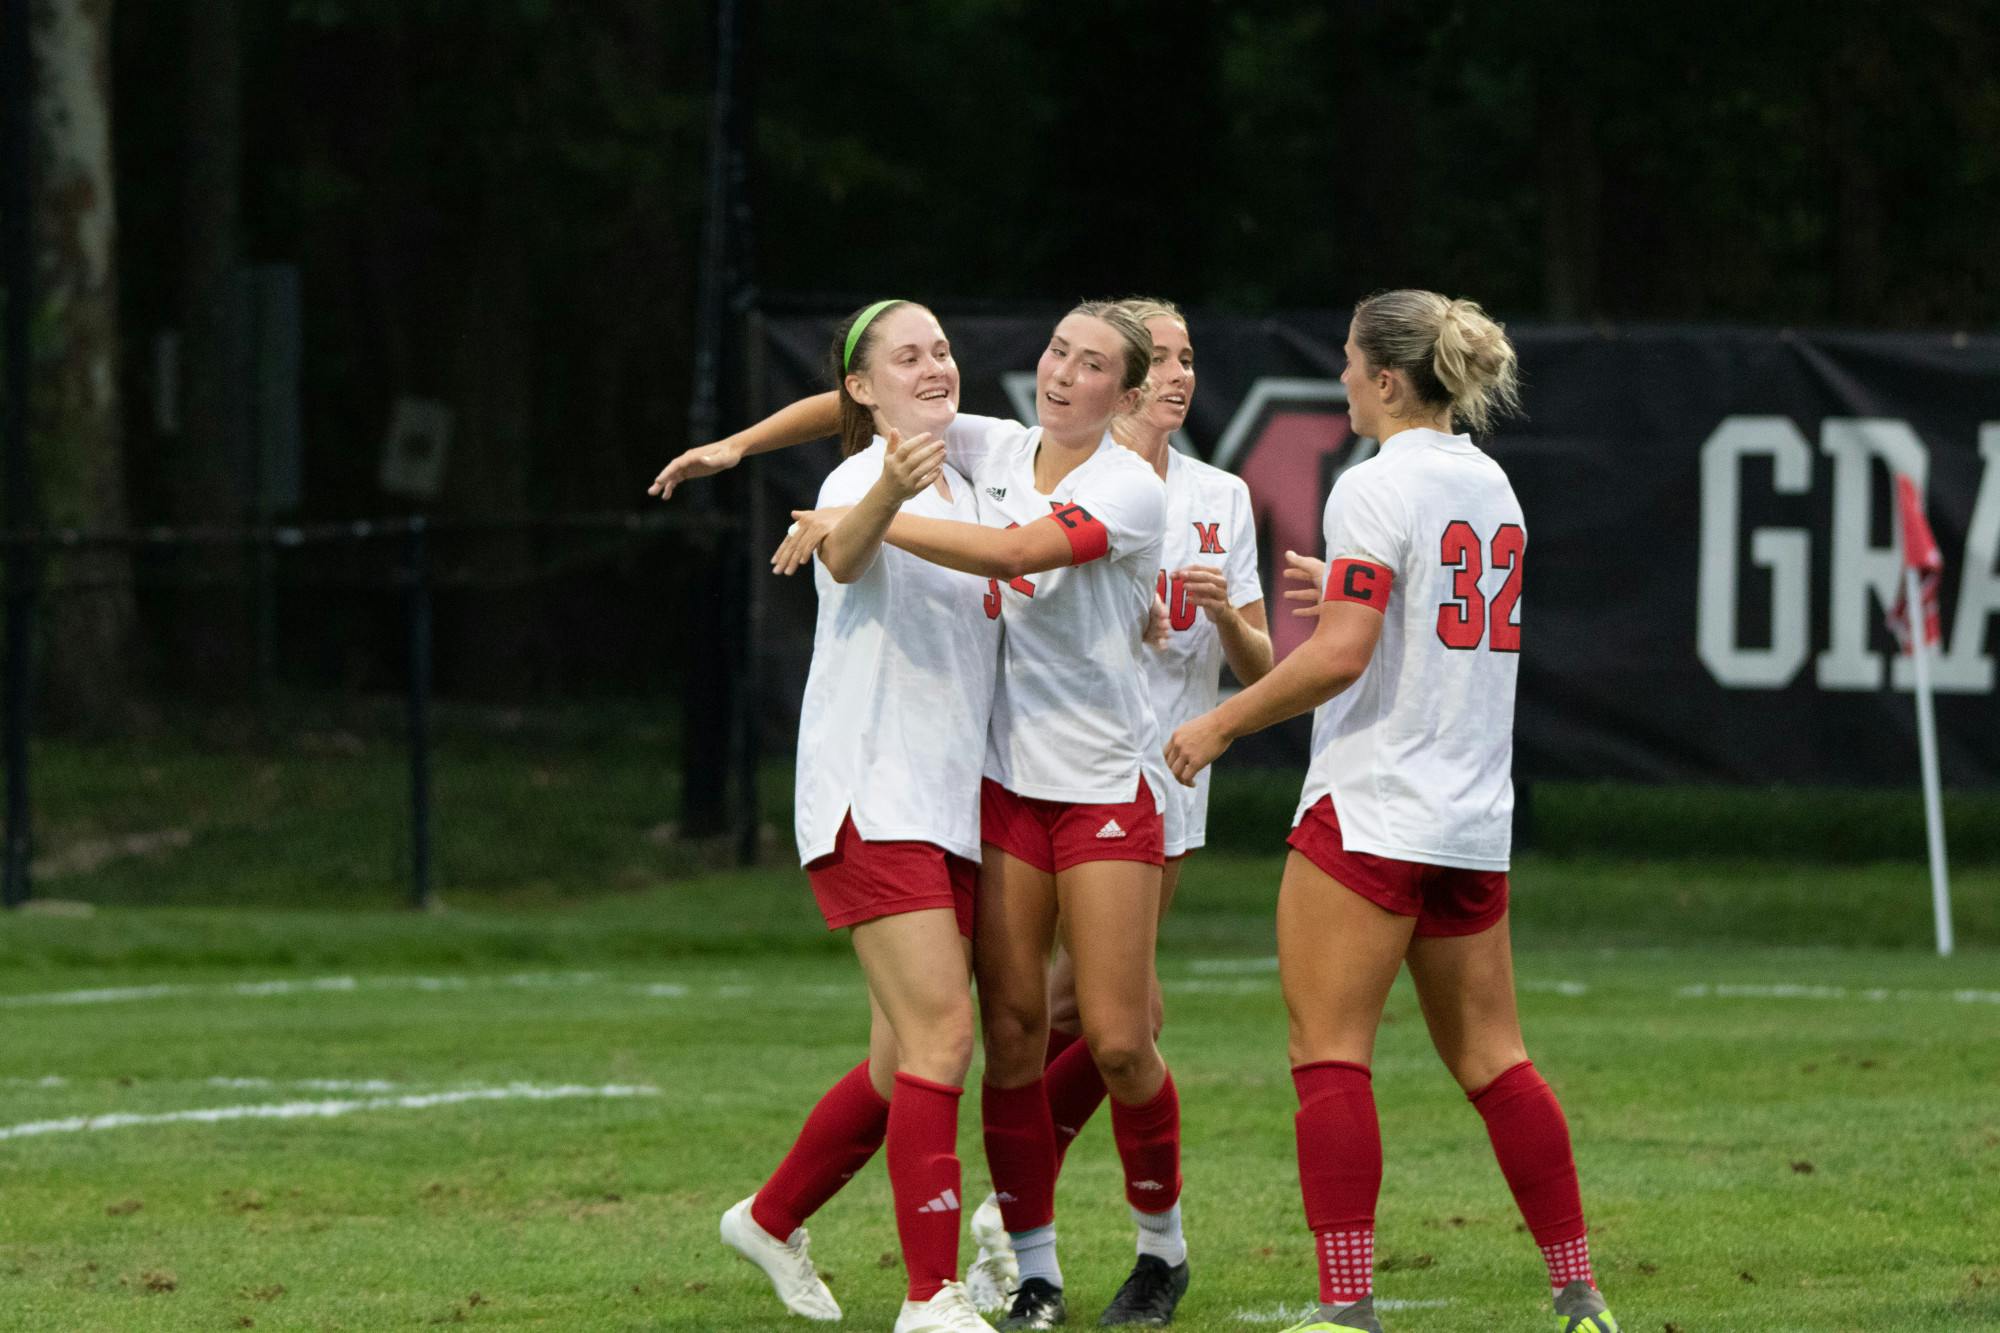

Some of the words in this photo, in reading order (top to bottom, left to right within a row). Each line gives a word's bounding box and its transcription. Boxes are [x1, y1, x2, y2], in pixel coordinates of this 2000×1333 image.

[1056, 505, 1093, 529] C
[1192, 522, 1227, 554] M
[1343, 564, 1376, 601] C
[1437, 520, 1523, 653] 32
